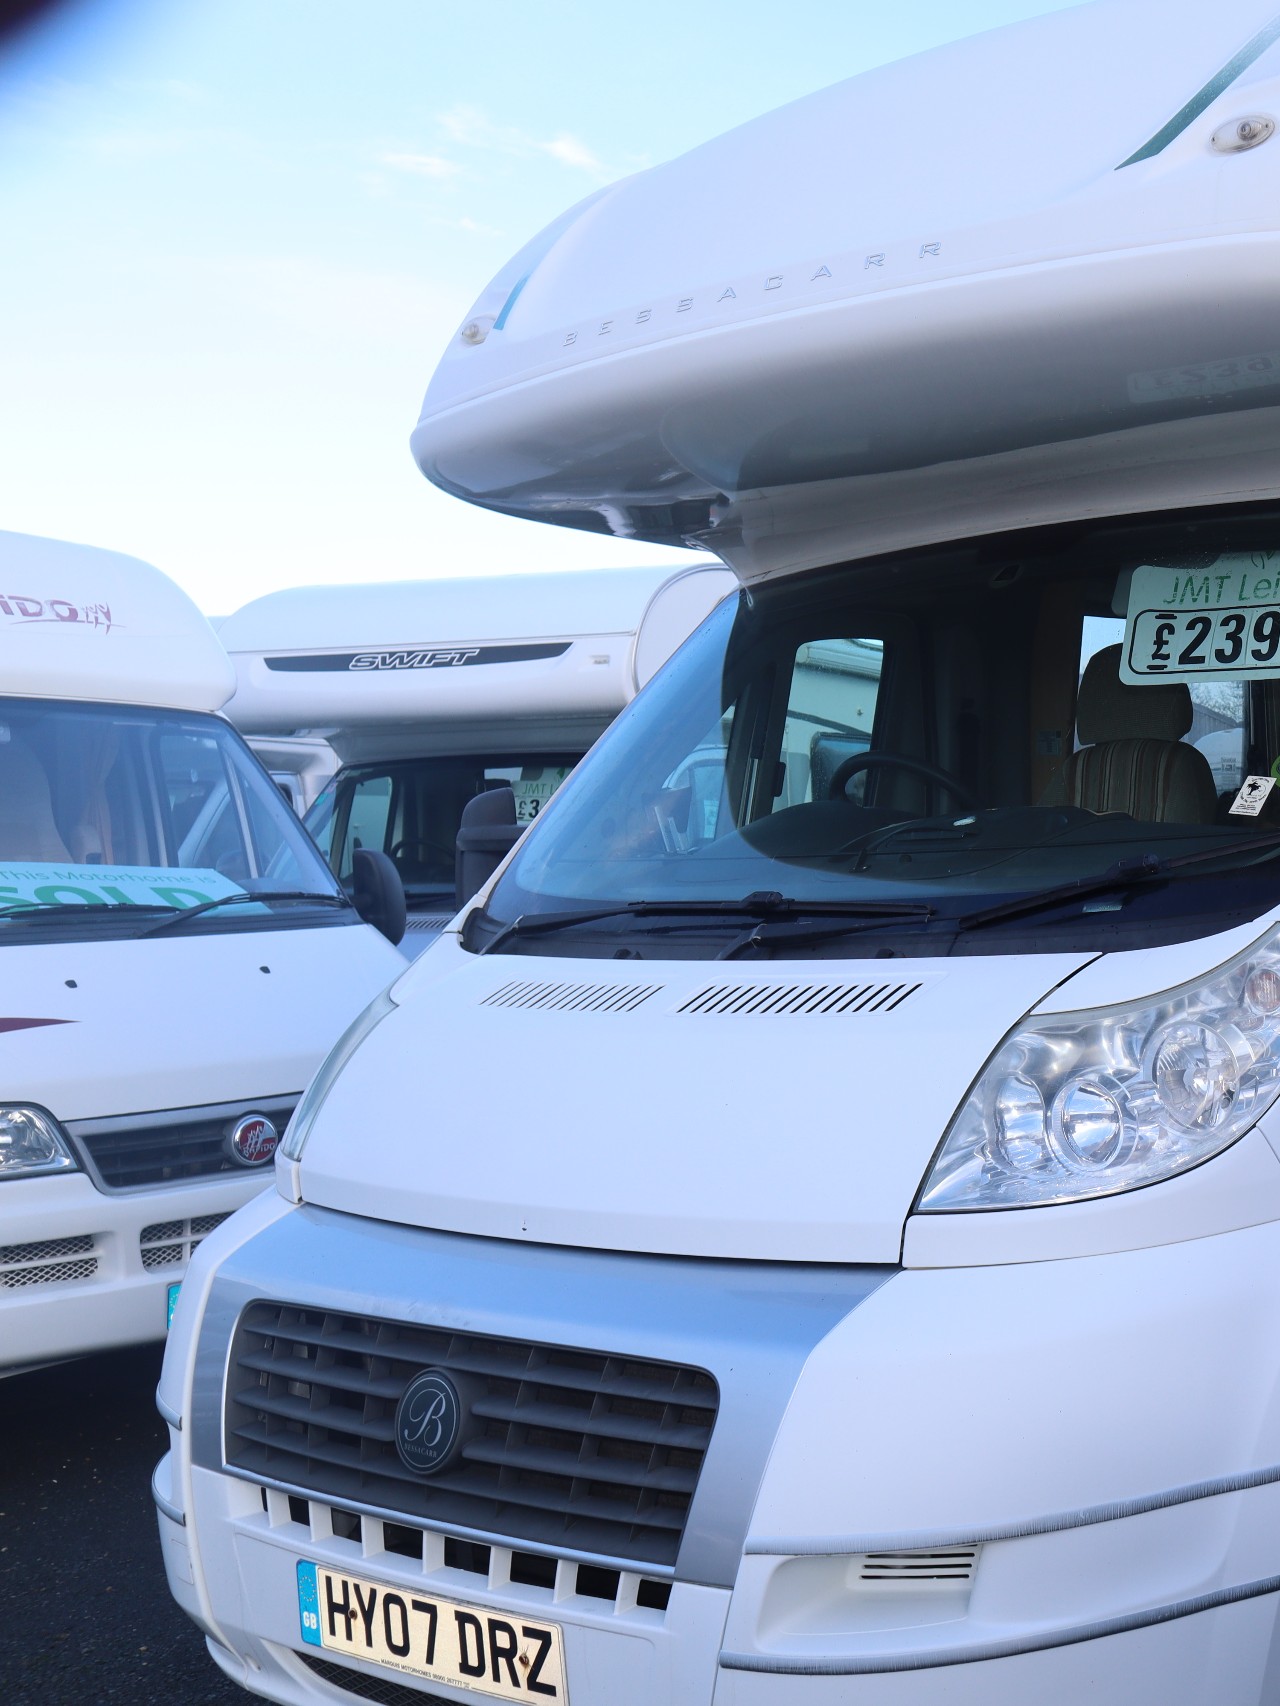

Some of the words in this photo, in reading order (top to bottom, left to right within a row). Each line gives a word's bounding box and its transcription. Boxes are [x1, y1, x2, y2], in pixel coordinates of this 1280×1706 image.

[562, 241, 942, 347] BESSACARR
[1163, 574, 1231, 605] JMT
[349, 648, 480, 671] SWIFT
[521, 783, 546, 795] JMT
[53, 870, 195, 884] Motorhome
[303, 1611, 317, 1630] GB
[325, 1576, 438, 1666] HY07
[454, 1610, 557, 1697] DRZ
